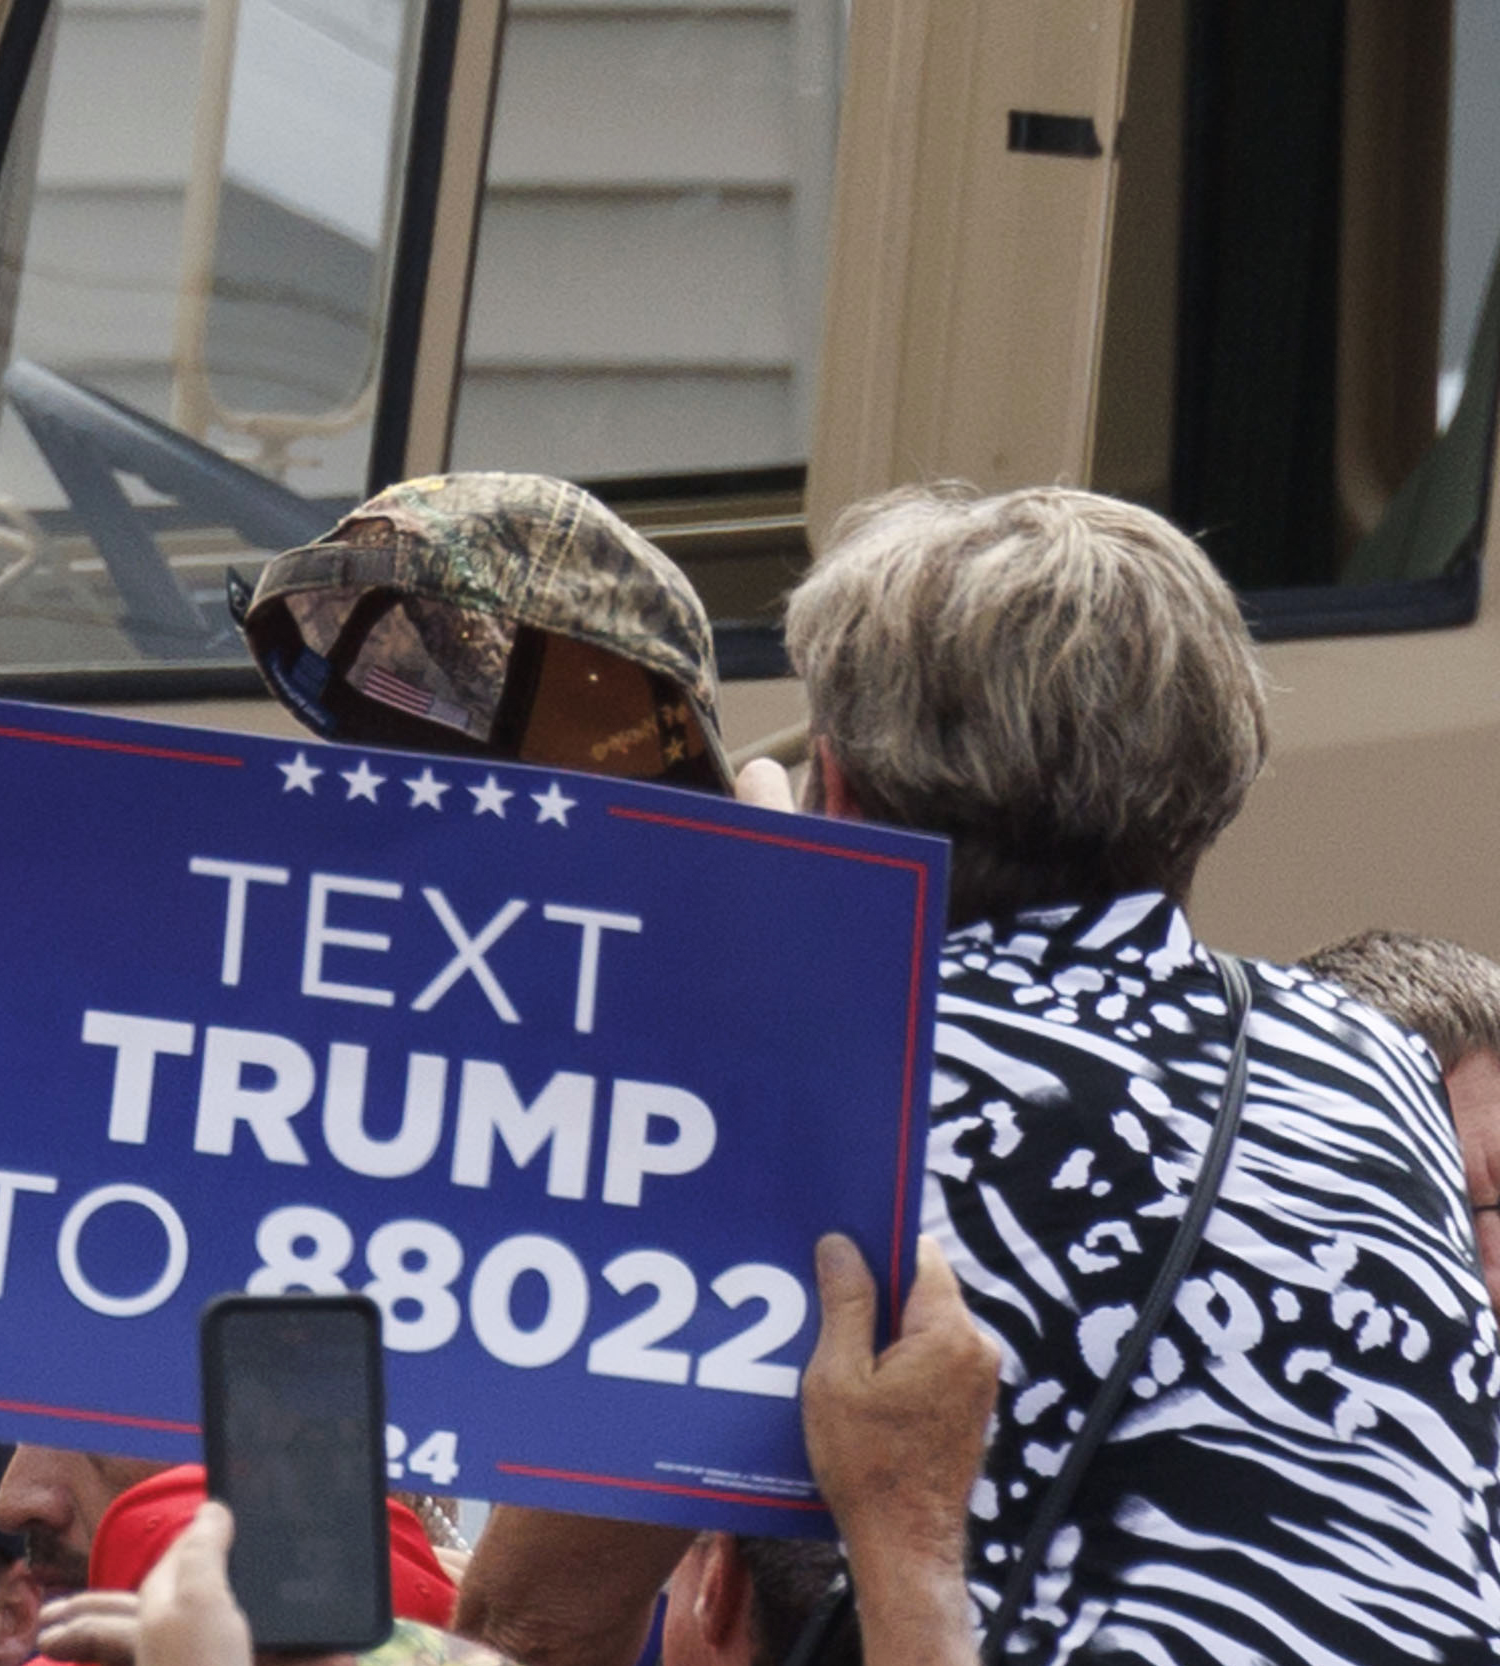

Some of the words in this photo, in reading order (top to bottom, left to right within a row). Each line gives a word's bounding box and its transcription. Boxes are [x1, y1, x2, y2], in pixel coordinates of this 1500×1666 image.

[189, 857, 642, 1033] TEXT
[82, 1010, 717, 1207] TRUMP
[245, 1205, 807, 1398] 88022
